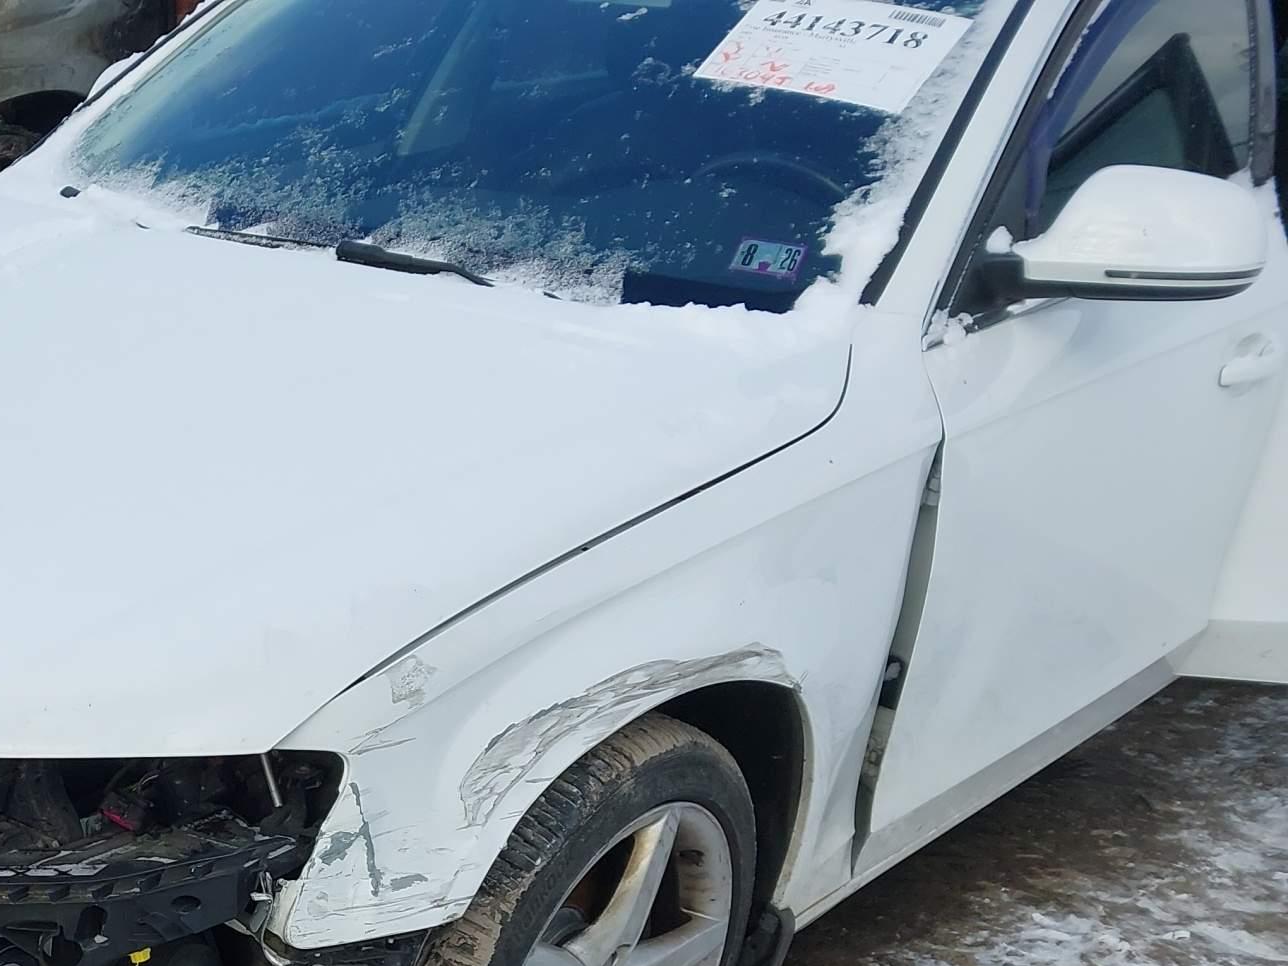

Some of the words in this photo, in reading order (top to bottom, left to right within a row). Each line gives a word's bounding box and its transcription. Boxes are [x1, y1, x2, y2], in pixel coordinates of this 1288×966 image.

[763, 11, 928, 49] 44143718
[741, 243, 759, 266] 8
[778, 248, 801, 271] 26
